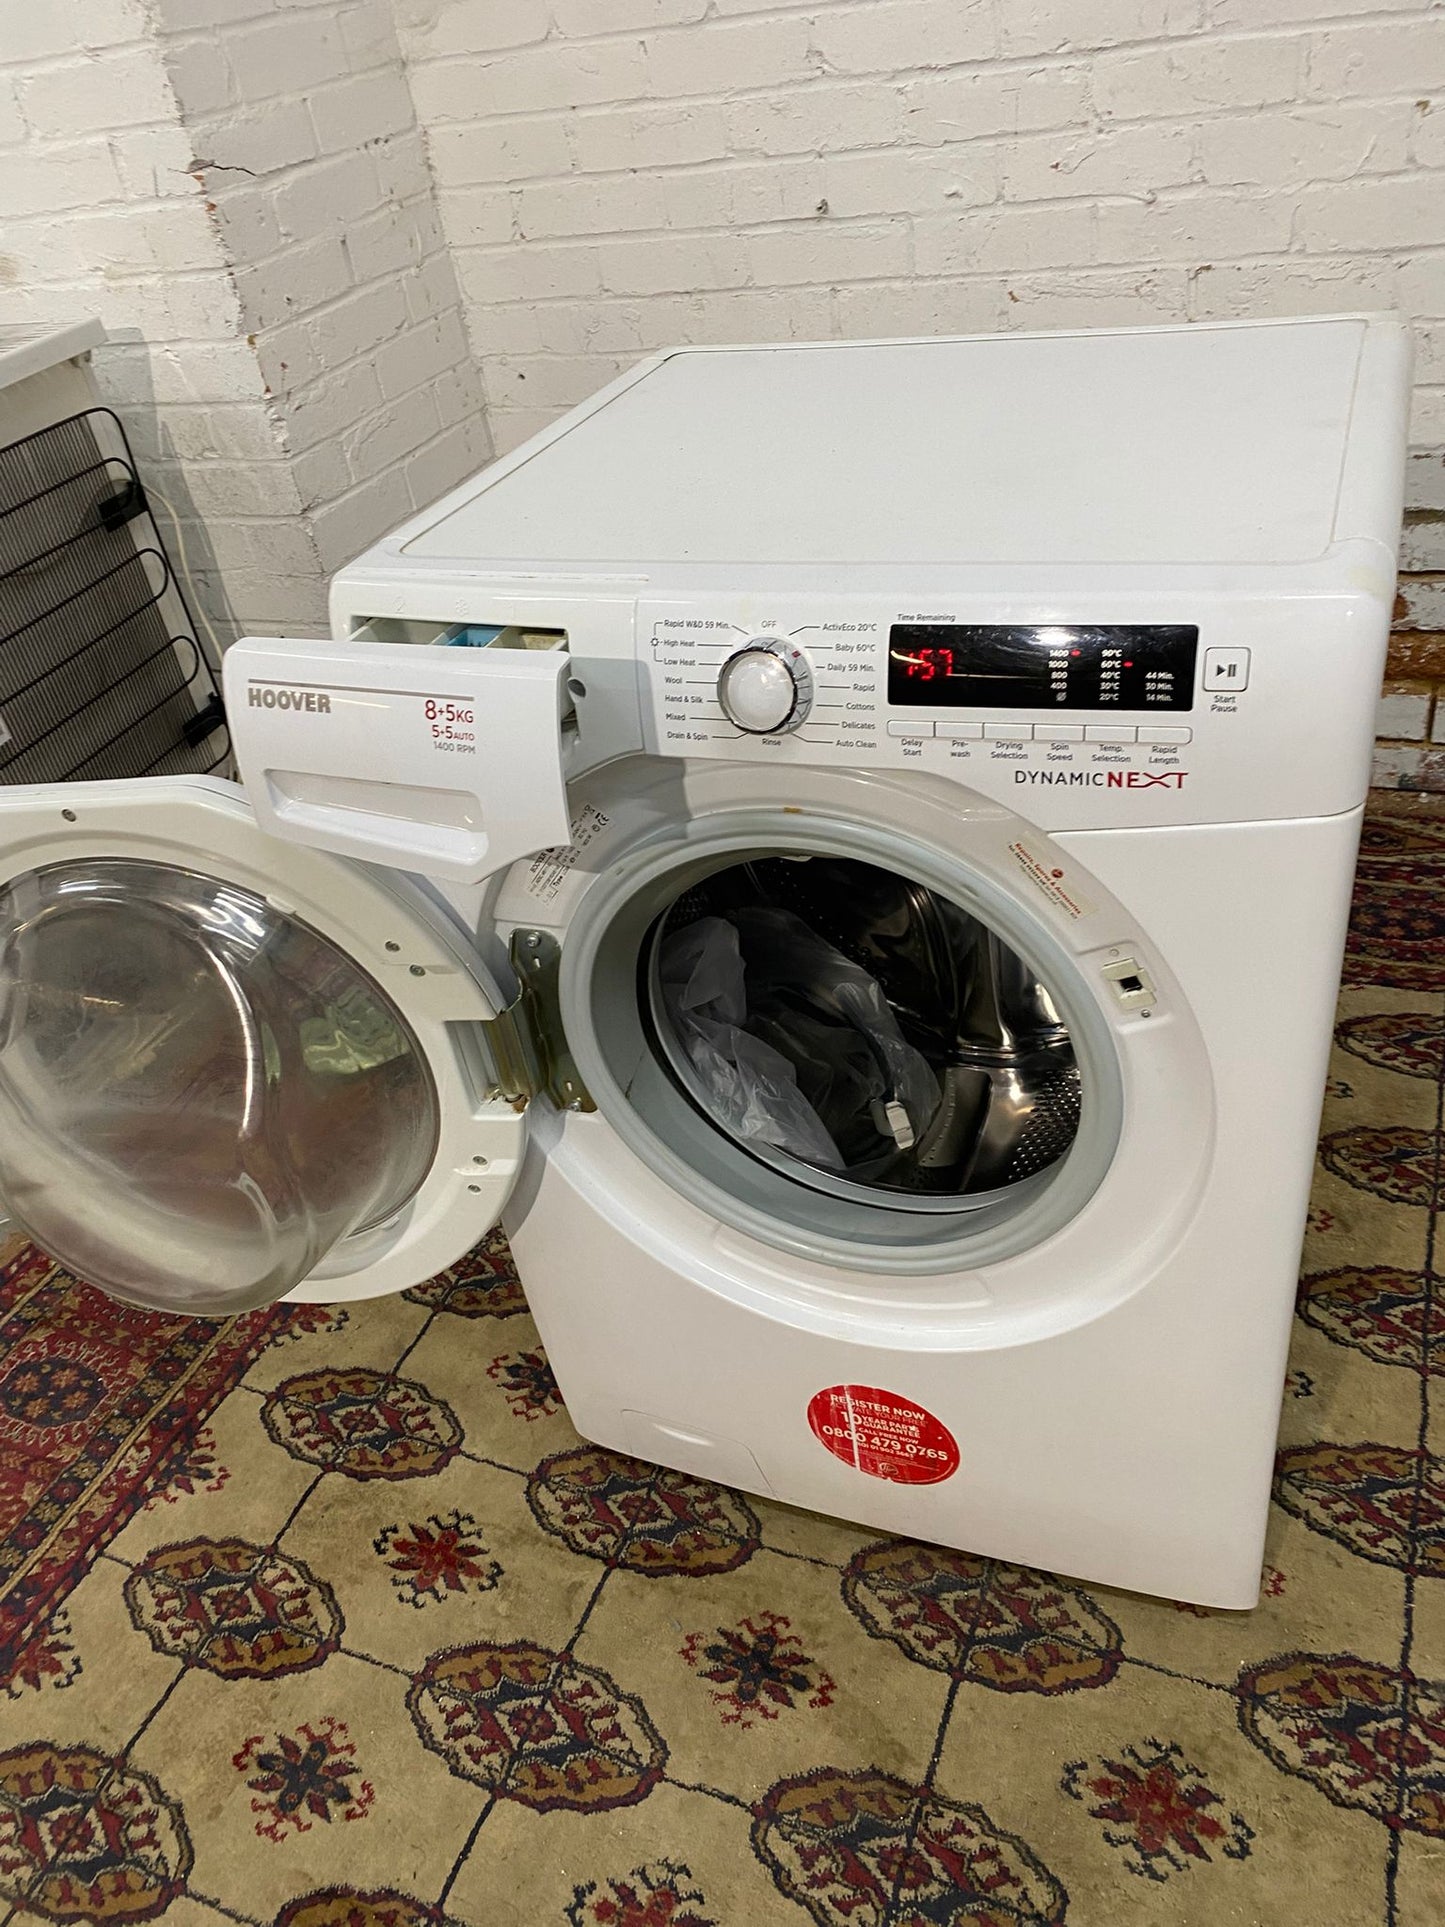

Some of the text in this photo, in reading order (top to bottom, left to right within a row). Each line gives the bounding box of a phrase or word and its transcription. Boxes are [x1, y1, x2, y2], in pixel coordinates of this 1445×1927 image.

[916, 614, 956, 622] Remaining
[664, 619, 730, 630] Rapid W&D 59 Min.
[761, 621, 777, 629] OFF
[822, 623, 877, 632] ActivEco 20°C
[664, 639, 695, 648] High Heat
[835, 644, 876, 654] Baby 60°C
[1049, 649, 1069, 657] 1400
[664, 658, 696, 667] Low Heat
[1048, 660, 1068, 668] 1000
[1101, 660, 1121, 668] 60°C
[827, 663, 875, 673] Daily 59 Min.
[1051, 671, 1068, 679] 800
[1100, 671, 1120, 679] 40°C
[665, 676, 682, 684] Wool
[853, 683, 875, 693] Rapid
[1050, 682, 1067, 690] 400
[1100, 682, 1120, 690] 30°C
[1145, 682, 1156, 690] 30
[248, 688, 332, 713] HOOVER
[665, 694, 703, 704] Hand & Silk
[1213, 695, 1235, 704] Start
[424, 699, 474, 723] 8+5KG
[846, 702, 875, 711] Cottons
[1210, 704, 1237, 713] Pause
[665, 713, 686, 722] Mixed
[841, 721, 876, 730] Delicates
[667, 731, 708, 742] Drain & Spin
[762, 738, 782, 747] Rinse
[836, 739, 877, 749] Auto Clean
[901, 739, 923, 749] Delay
[952, 740, 969, 748] Pre-
[995, 741, 1023, 751] Drying
[1051, 742, 1069, 752] Spin
[433, 741, 476, 754] 1400 RPM
[1152, 745, 1178, 756] Rapid
[902, 749, 922, 757] Start
[950, 750, 971, 758] wash
[990, 751, 1028, 760] Selection
[1047, 753, 1073, 763] Speed
[1091, 754, 1131, 763] Selection
[1148, 756, 1180, 766] Length
[830, 1394, 926, 1421] REGISTER NOW
[840, 1411, 862, 1425] 10
[874, 1410, 901, 1420] YOUR
[861, 1415, 887, 1426] YEAR
[863, 1421, 921, 1439] GUARANTEE
[858, 1427, 878, 1436] CALL
[878, 1431, 899, 1440] FREE
[899, 1436, 919, 1445] NOW
[822, 1425, 867, 1442] 0800
[870, 1436, 902, 1450] 479
[905, 1443, 948, 1461] 0765
